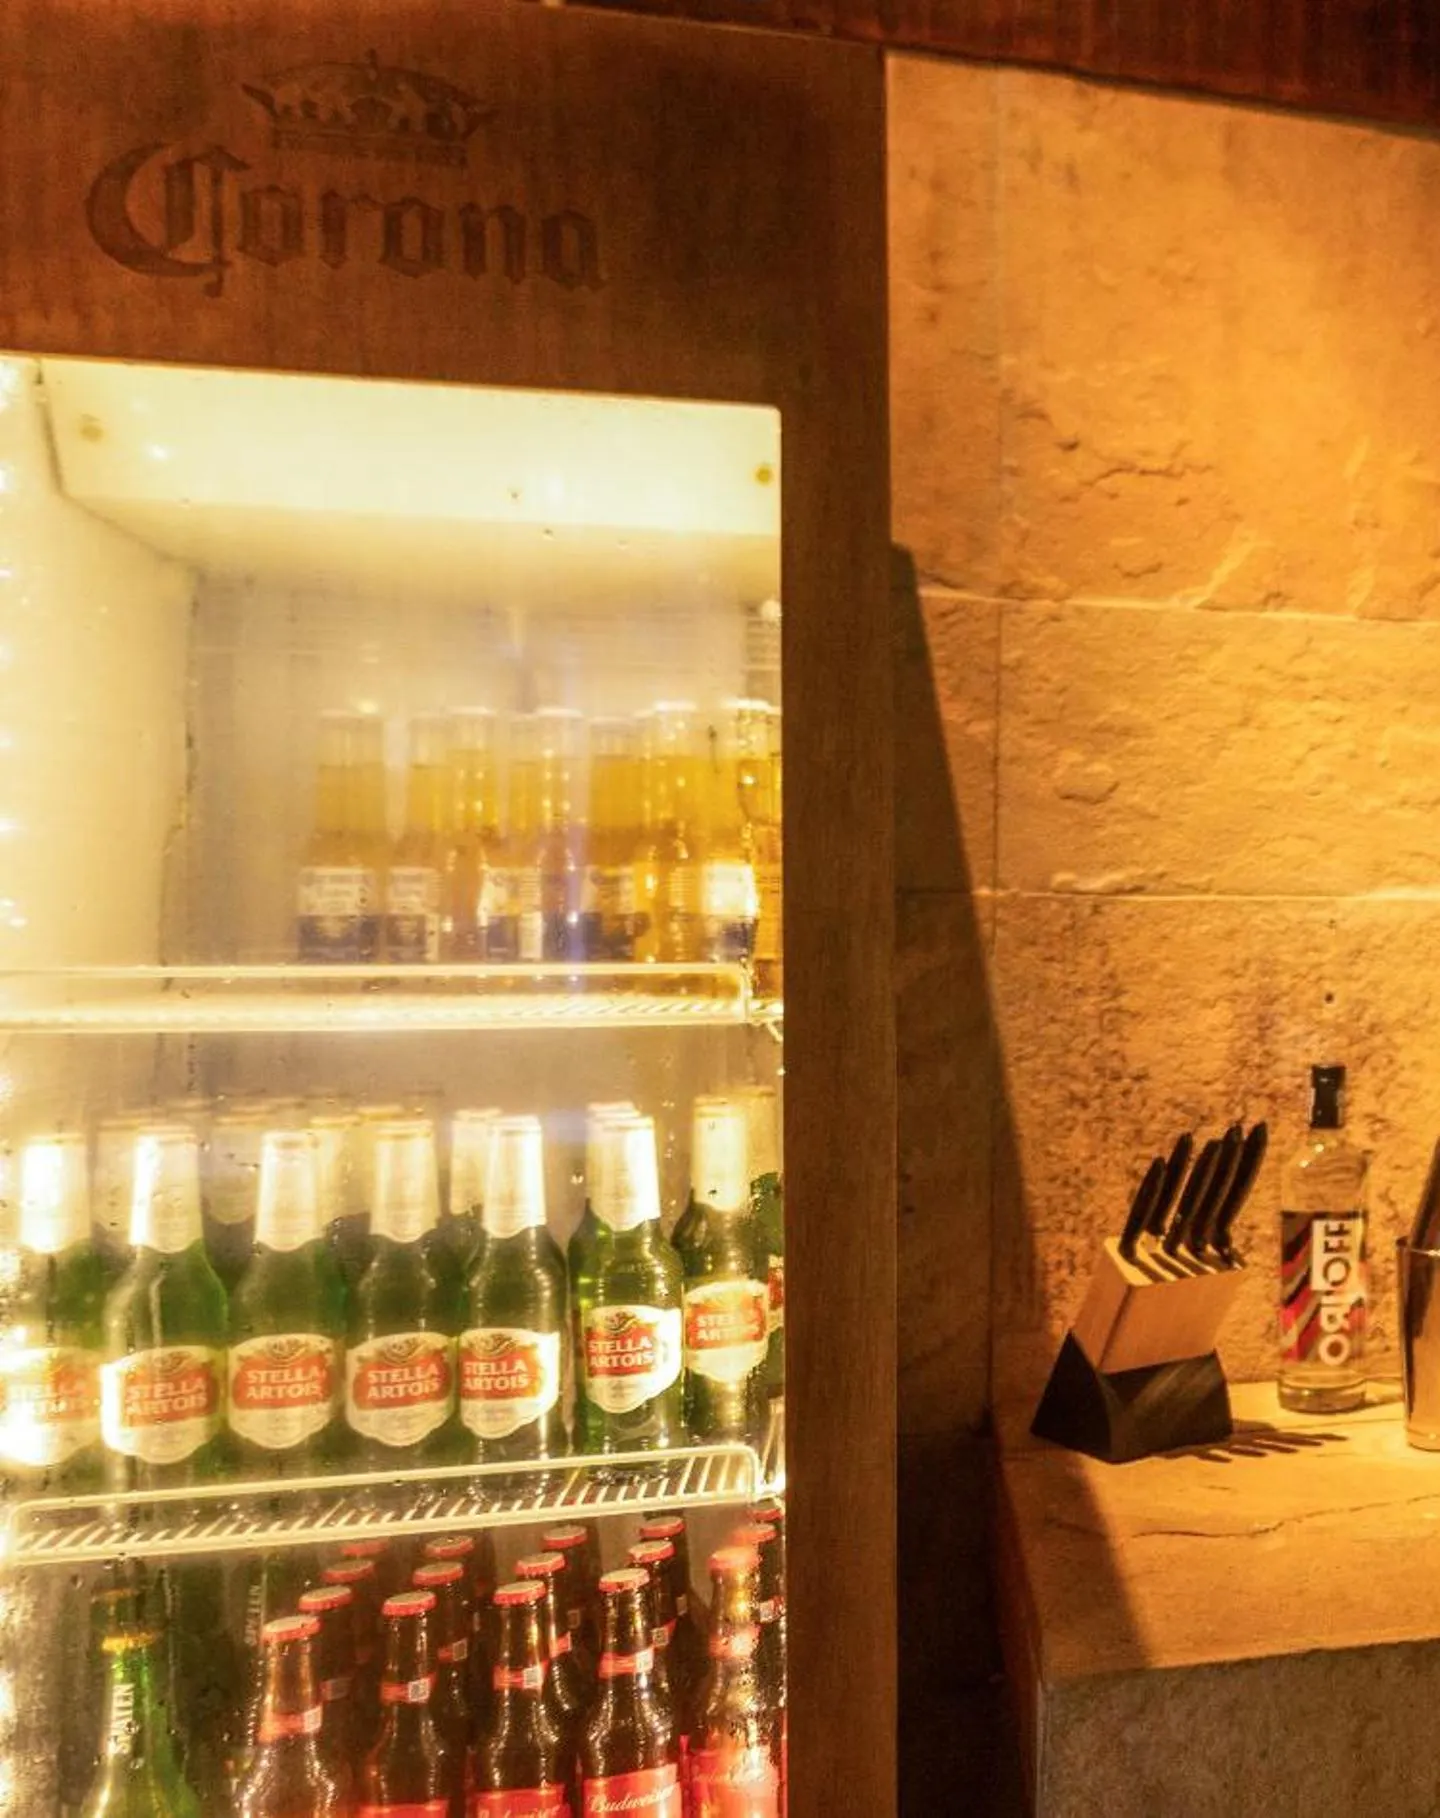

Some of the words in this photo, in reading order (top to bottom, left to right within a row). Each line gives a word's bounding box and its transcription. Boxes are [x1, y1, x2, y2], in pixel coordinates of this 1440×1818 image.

[84, 142, 605, 297] Corona
[588, 1336, 653, 1353] STELLA
[463, 1357, 529, 1375] STELLA
[590, 1352, 654, 1368] ARTOIS
[245, 1365, 321, 1384] STELLA
[367, 1363, 439, 1383] STELLA
[463, 1374, 529, 1391] ARTOIS
[126, 1377, 207, 1400] STELLA
[246, 1381, 322, 1400] ARTOIS
[367, 1380, 440, 1400] ARTOIS
[590, 1786, 675, 1813] Budweiser
